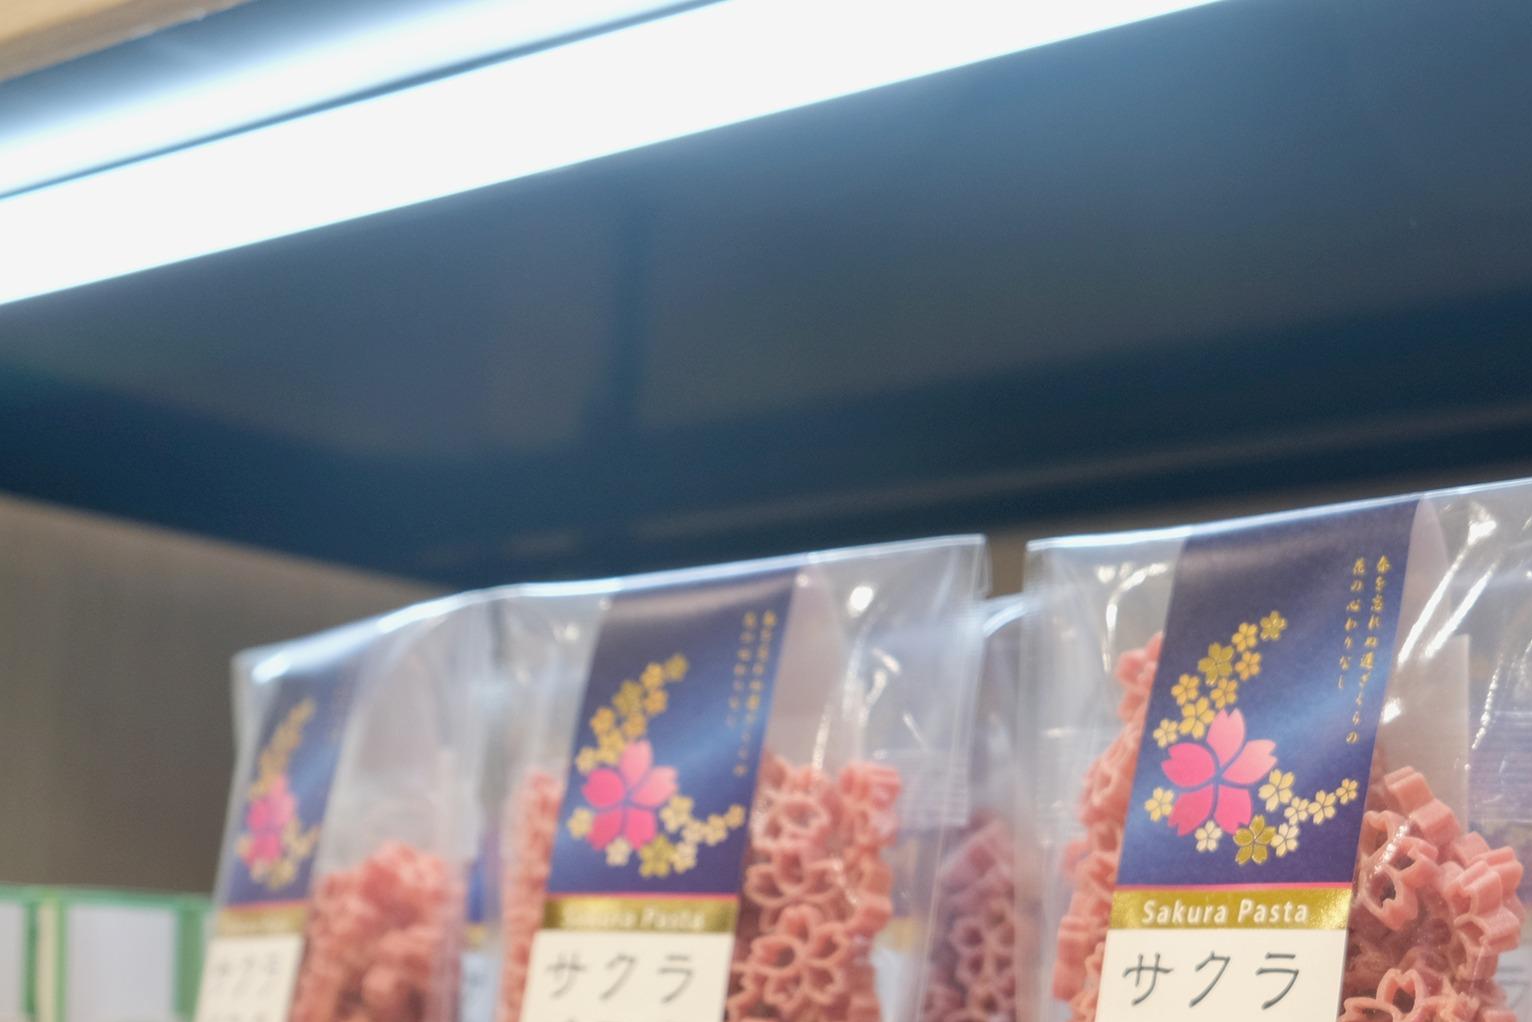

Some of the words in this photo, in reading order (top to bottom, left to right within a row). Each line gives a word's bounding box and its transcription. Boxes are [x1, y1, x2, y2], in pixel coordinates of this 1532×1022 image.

[1142, 898, 1228, 926] Sakura
[1237, 897, 1309, 924] Pasta
[544, 951, 696, 1005] サクラ
[1121, 950, 1301, 1011] サクラ
